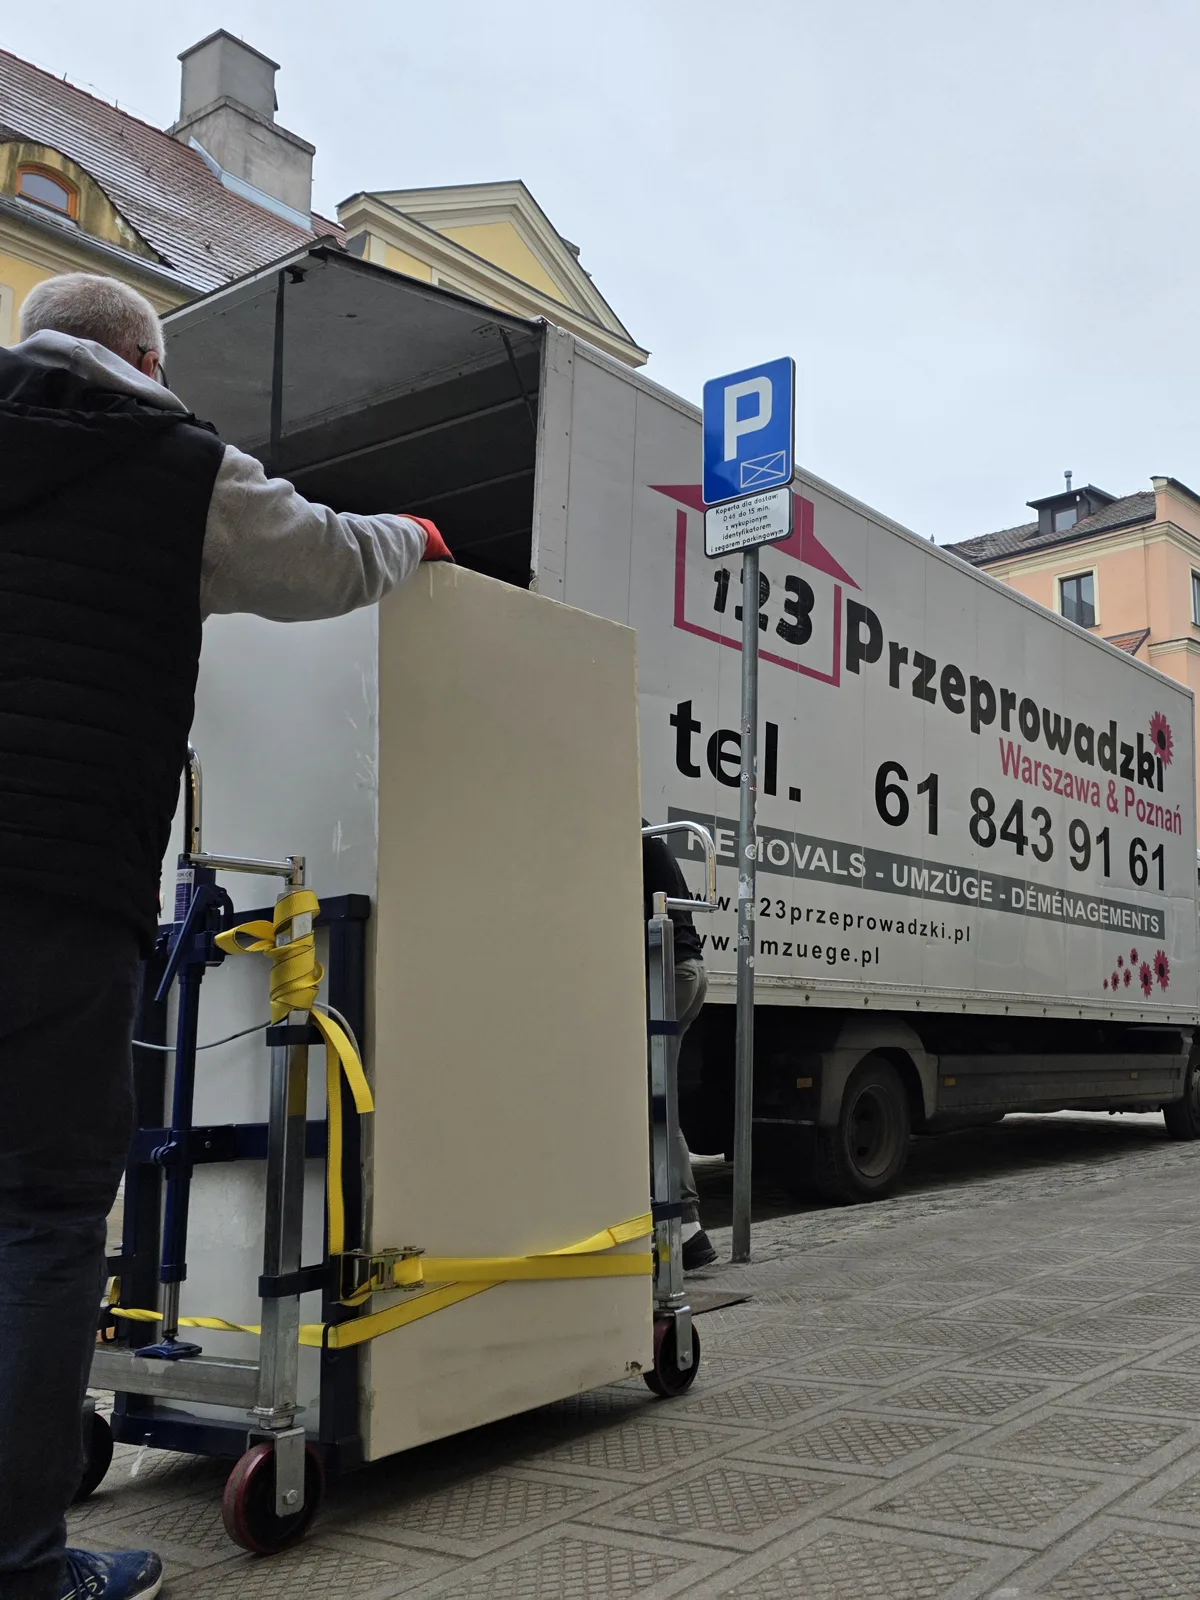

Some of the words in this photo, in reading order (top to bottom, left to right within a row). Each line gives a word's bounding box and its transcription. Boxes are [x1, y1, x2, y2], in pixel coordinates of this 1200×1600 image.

[723, 376, 773, 462] P
[715, 504, 740, 515] Koperta
[722, 523, 772, 541] identyfikatorem
[730, 514, 768, 530] wykupionym
[756, 505, 771, 513] min.
[714, 540, 740, 552] zegarem
[742, 529, 784, 546] parkingowym
[845, 597, 1165, 793] Przeprowadzki
[669, 699, 802, 803] tel.
[874, 760, 939, 837] 61
[969, 787, 1054, 863] 843
[1069, 818, 1111, 879] 91
[1128, 836, 1165, 892] 61
[998, 737, 1101, 808] Warszawa
[1106, 779, 1119, 815] &
[1124, 785, 1183, 836] Poznań
[892, 862, 993, 902] UMZÜGE
[1011, 885, 1160, 933] DÉMÉNAGEMENTS
